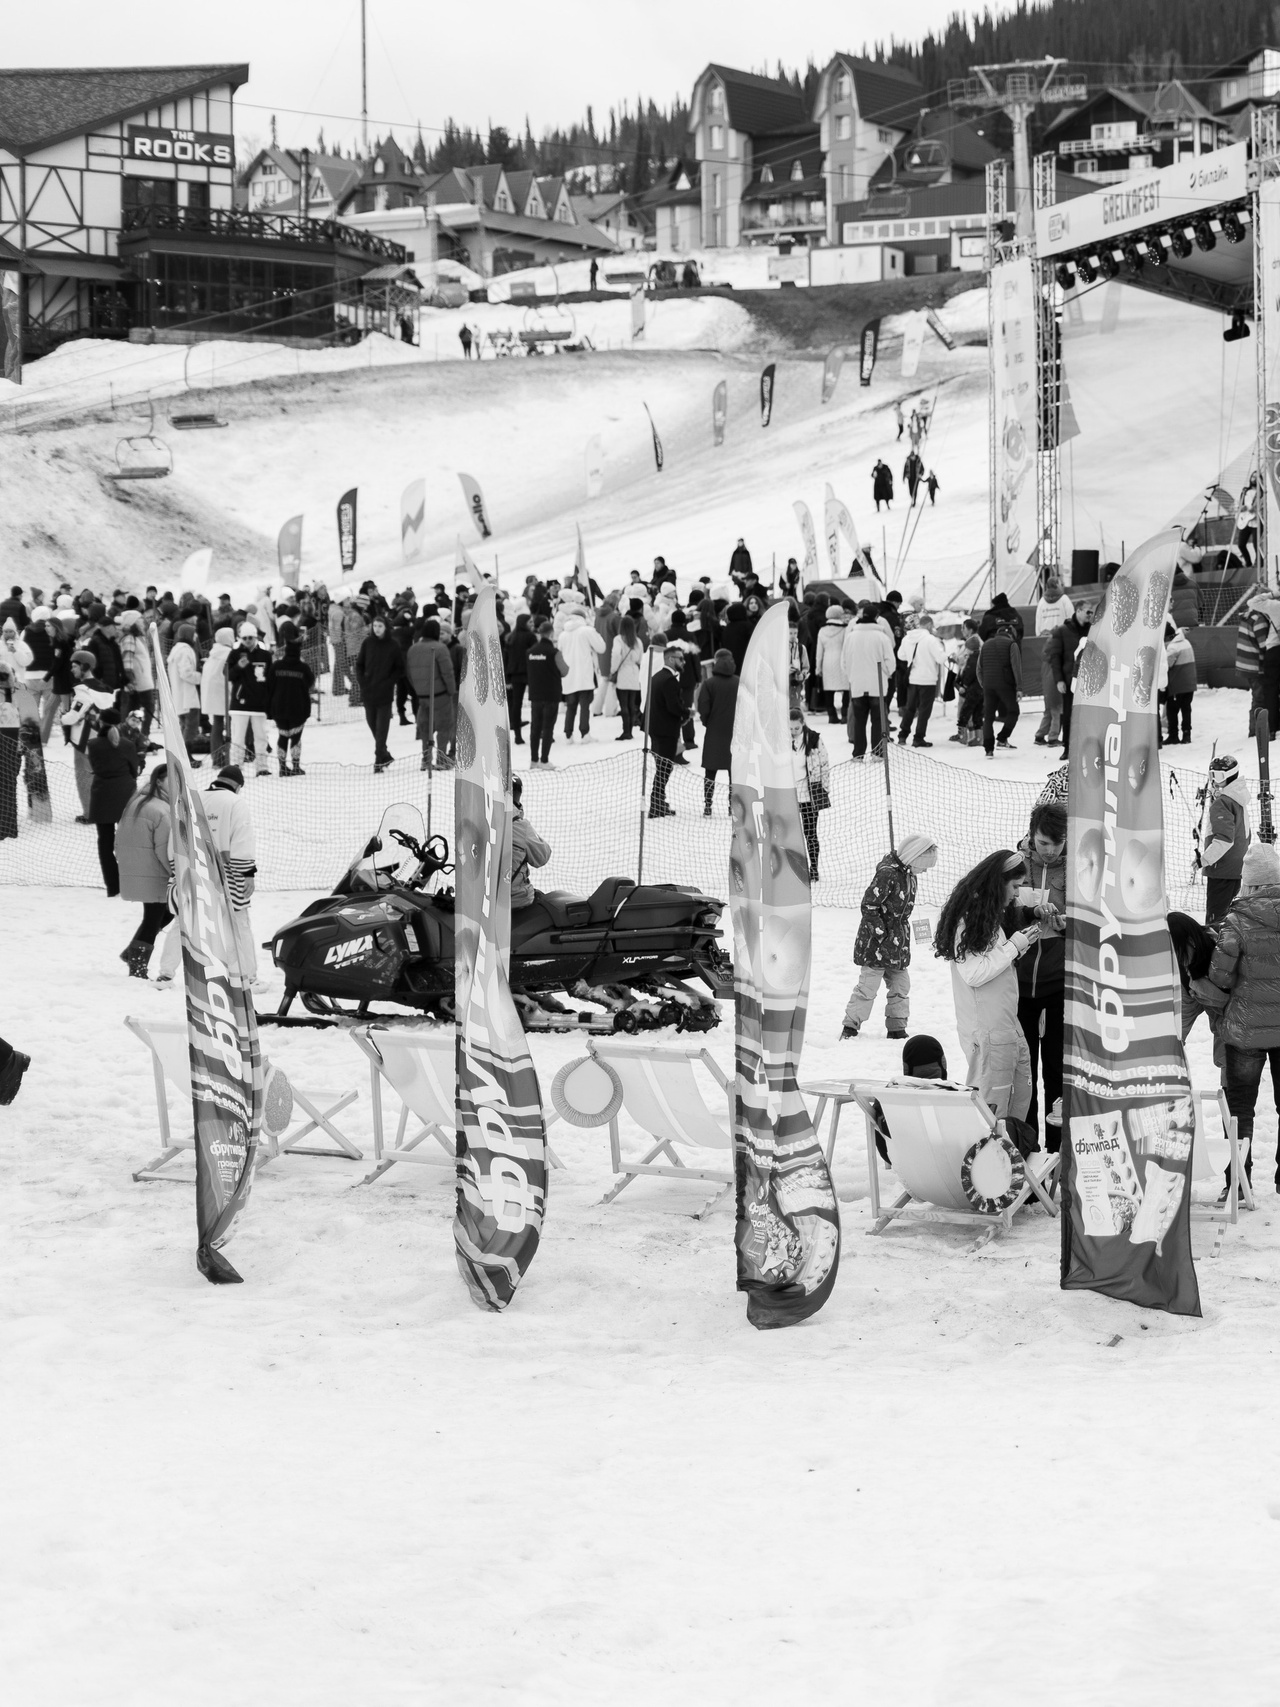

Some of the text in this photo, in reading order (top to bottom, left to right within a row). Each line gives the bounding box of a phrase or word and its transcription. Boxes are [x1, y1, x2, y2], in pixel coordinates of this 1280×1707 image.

[170, 130, 196, 141] THE
[134, 137, 232, 164] ROOKS
[1094, 661, 1136, 1053] фрутилад
[324, 934, 373, 966] LYNX
[334, 955, 365, 969] YETI
[1118, 1082, 1166, 1097] семьи
[1075, 1136, 1122, 1155] фртилад
